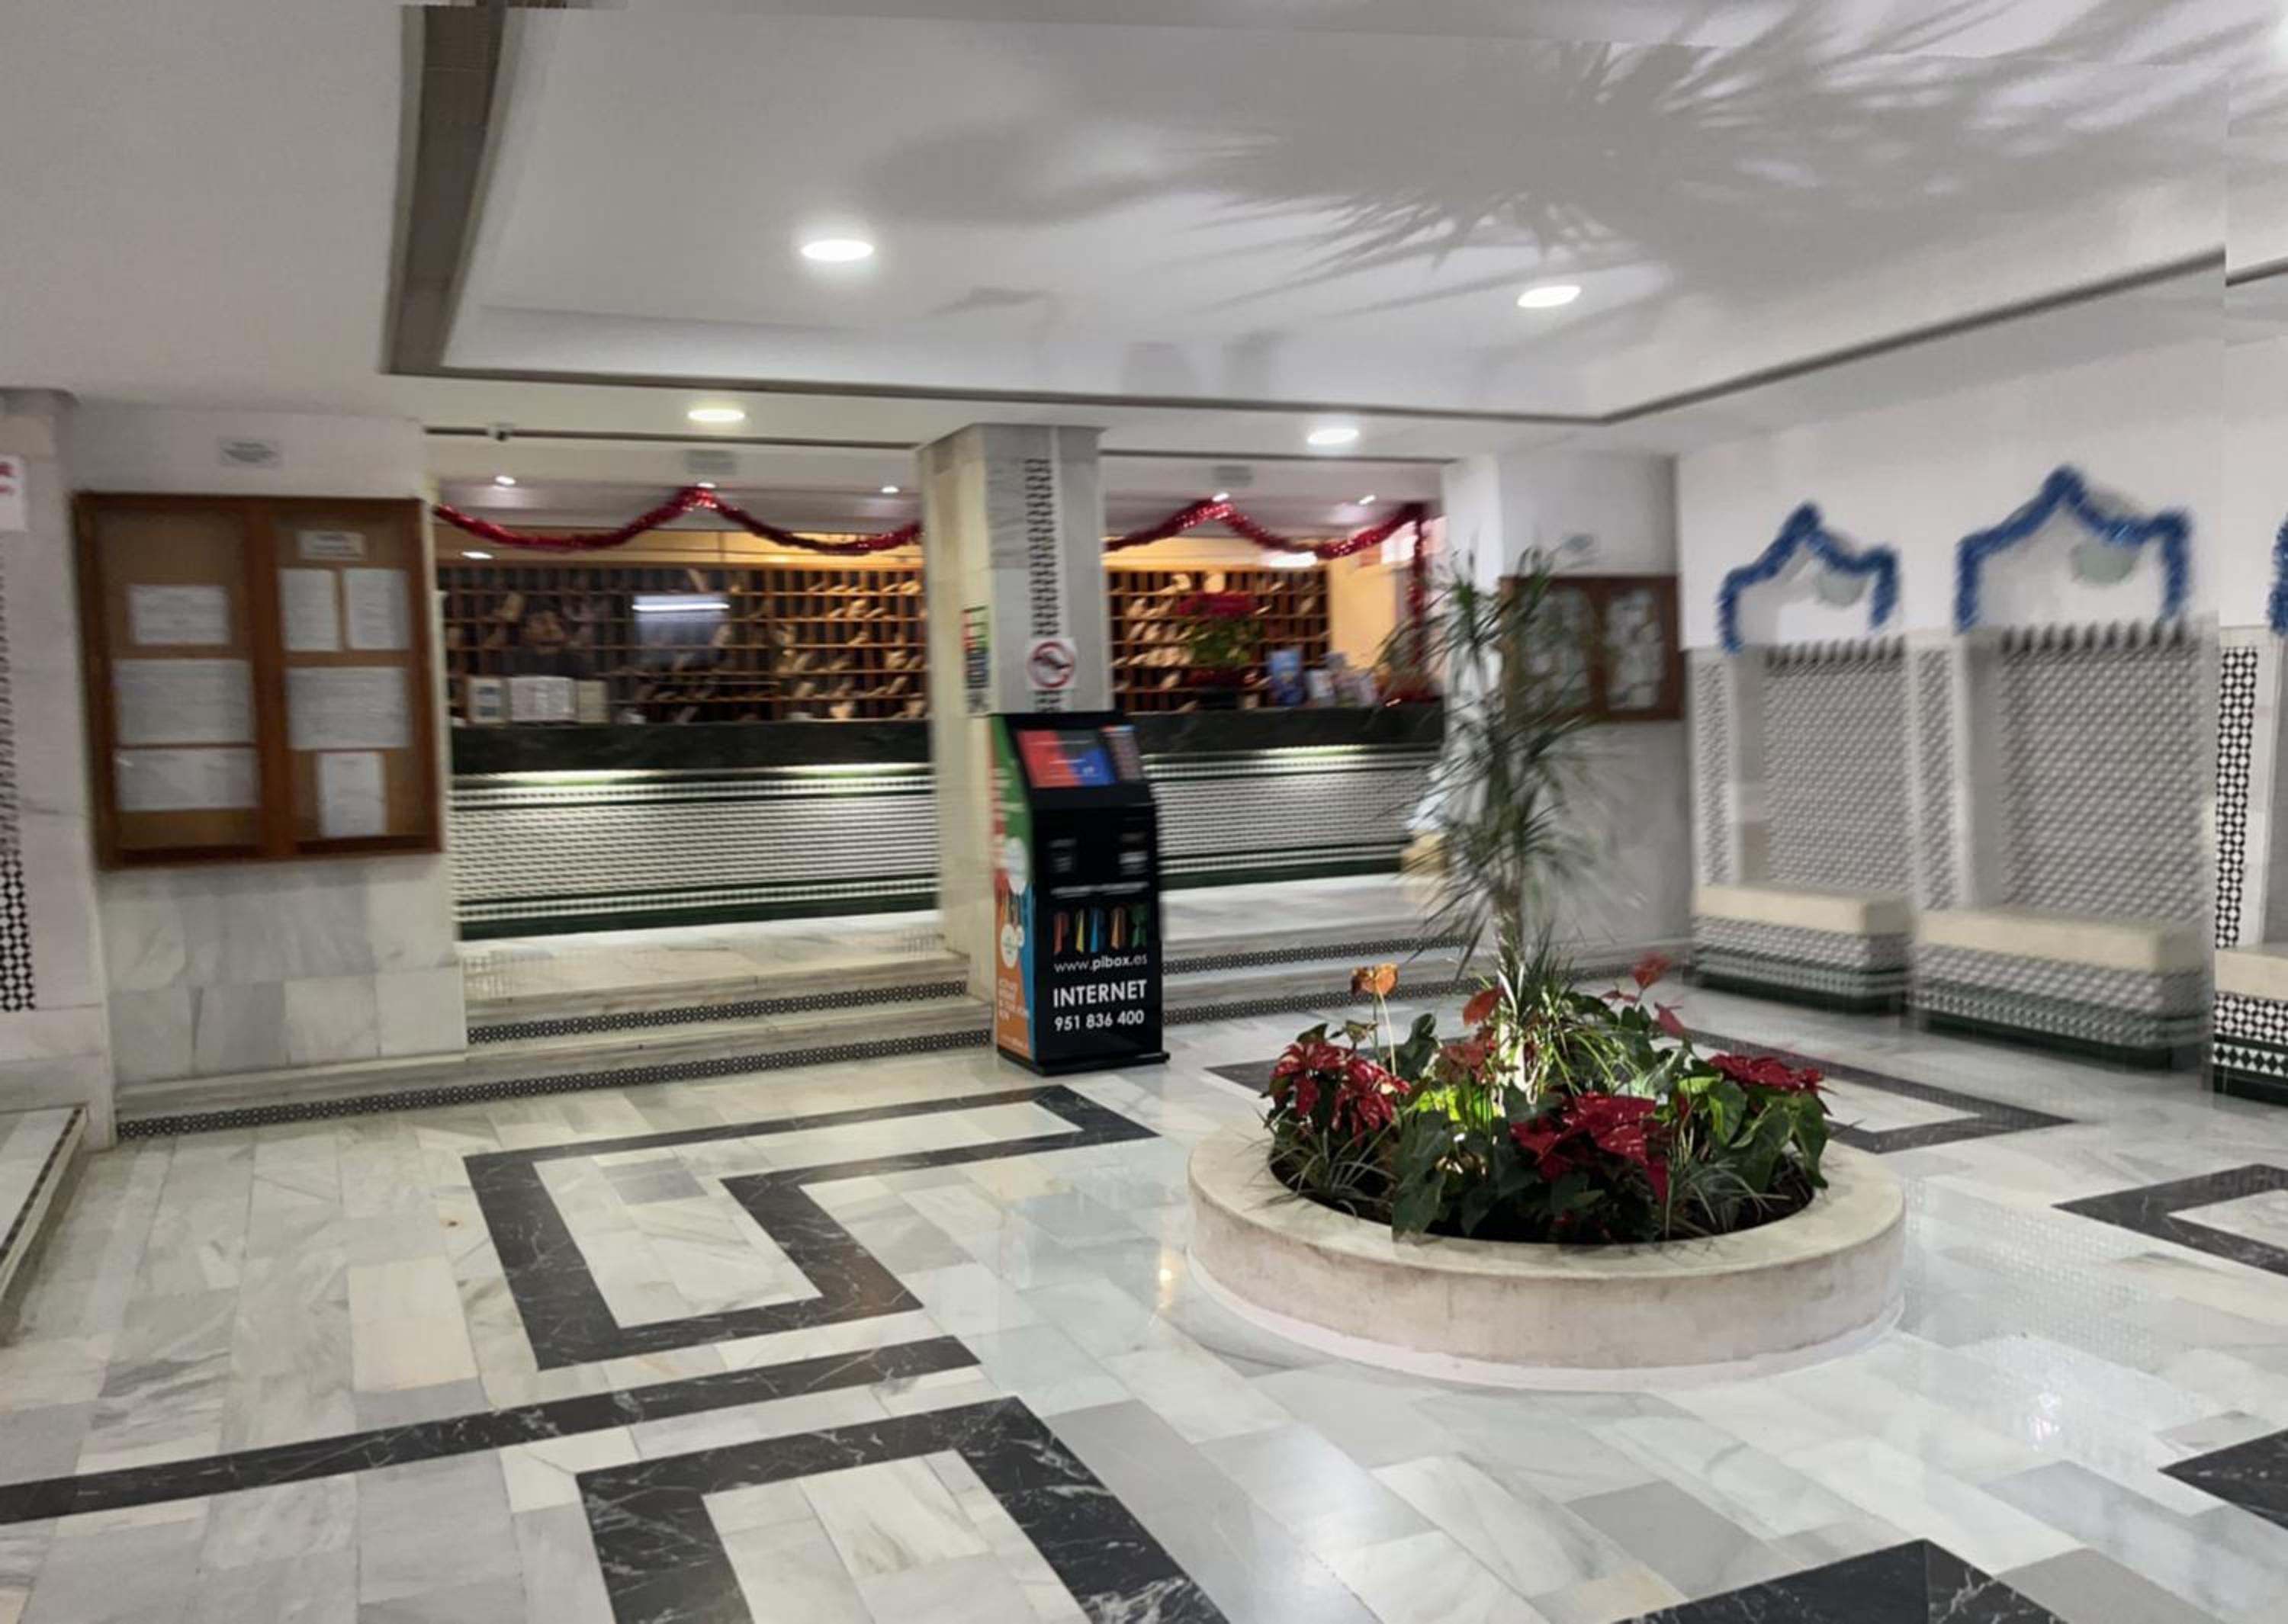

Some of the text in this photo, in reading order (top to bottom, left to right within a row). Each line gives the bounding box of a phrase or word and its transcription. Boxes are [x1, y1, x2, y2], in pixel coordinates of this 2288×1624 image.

[1052, 978, 1147, 1008] INTERNET
[1054, 1009, 1145, 1032] 951 836 400
